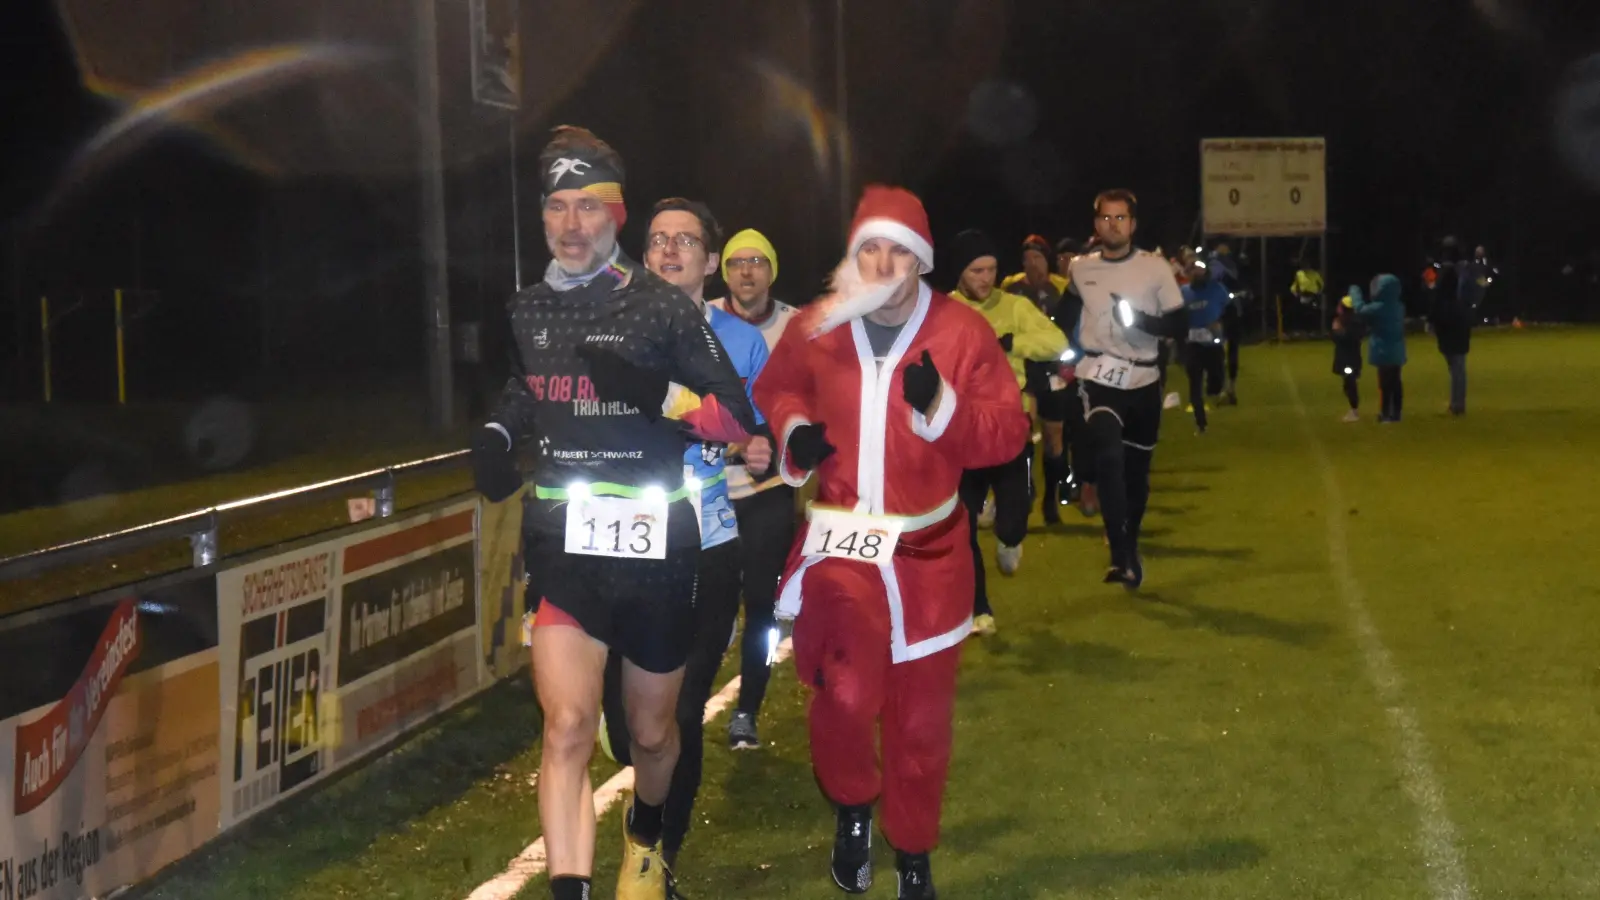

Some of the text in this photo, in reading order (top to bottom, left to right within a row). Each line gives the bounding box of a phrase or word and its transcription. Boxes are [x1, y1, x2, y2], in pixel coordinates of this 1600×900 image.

[1229, 186, 1301, 206] 0 0
[547, 375, 572, 402] 08
[1092, 364, 1124, 386] 141
[553, 449, 643, 459] HUBERT SCHWARZ
[582, 517, 652, 555] 113
[814, 529, 883, 559] 148
[22, 737, 50, 797] Auch
[84, 605, 137, 722] Vereinsfest
[17, 857, 37, 900] aus
[41, 837, 60, 890] der
[62, 821, 100, 890] Region
